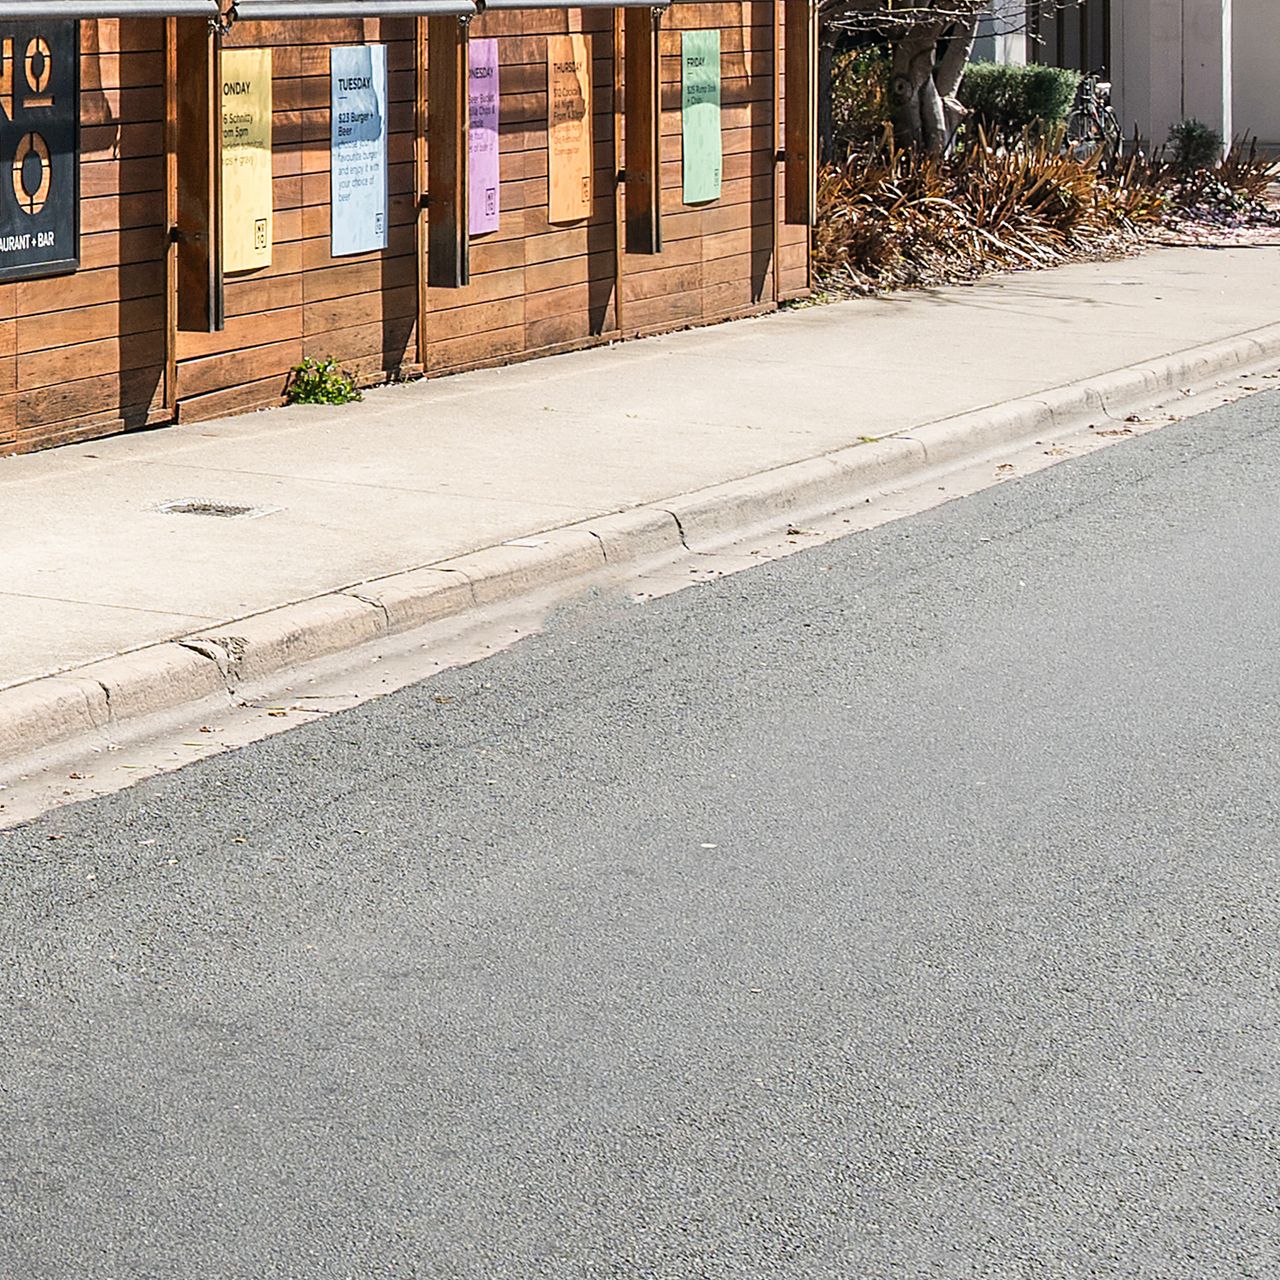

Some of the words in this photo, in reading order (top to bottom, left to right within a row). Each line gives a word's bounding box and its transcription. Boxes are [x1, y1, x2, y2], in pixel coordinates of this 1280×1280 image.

[553, 61, 582, 74] THURSDAY
[687, 57, 705, 67] FRIDAY
[469, 66, 493, 79] NESDAY
[223, 81, 251, 96] ONDAY
[338, 77, 371, 91] TUESDAY
[351, 112, 369, 124] Burger
[338, 126, 352, 137] Beer
[37, 232, 54, 248] BAR
